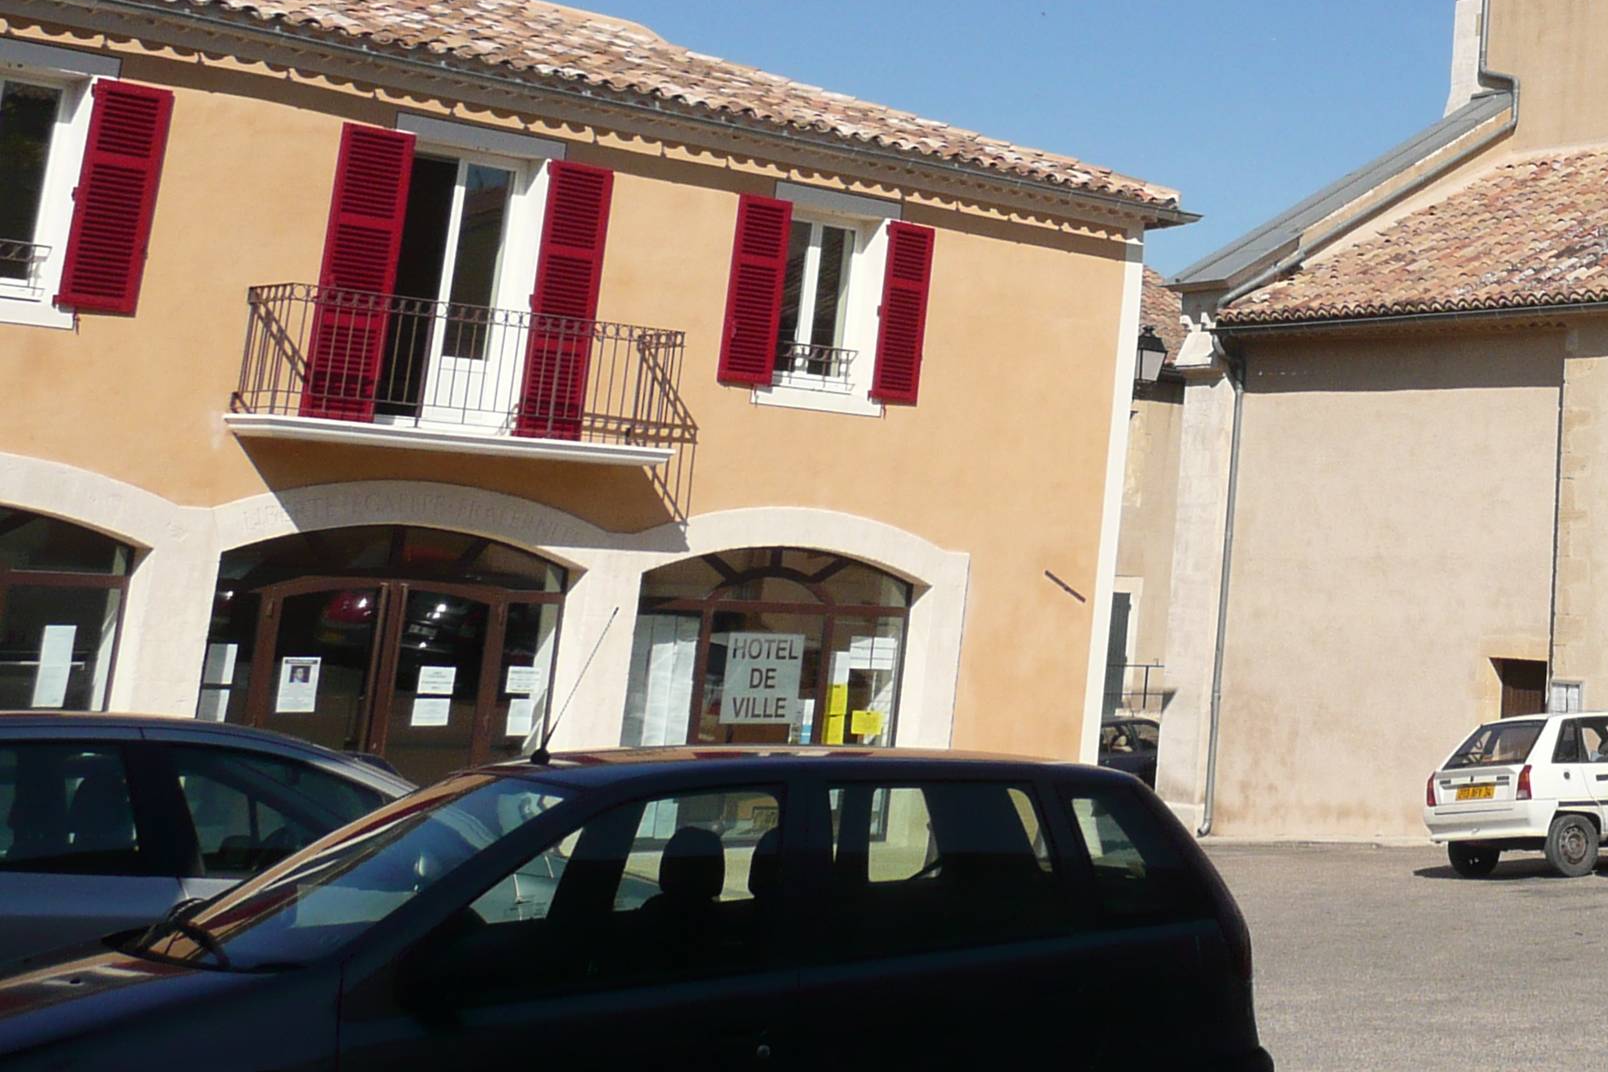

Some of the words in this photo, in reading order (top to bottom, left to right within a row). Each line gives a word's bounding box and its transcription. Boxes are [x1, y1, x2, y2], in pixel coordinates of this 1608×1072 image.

[732, 639, 798, 660] HOTEL
[749, 668, 777, 690] DE
[732, 697, 787, 719] VILLE
